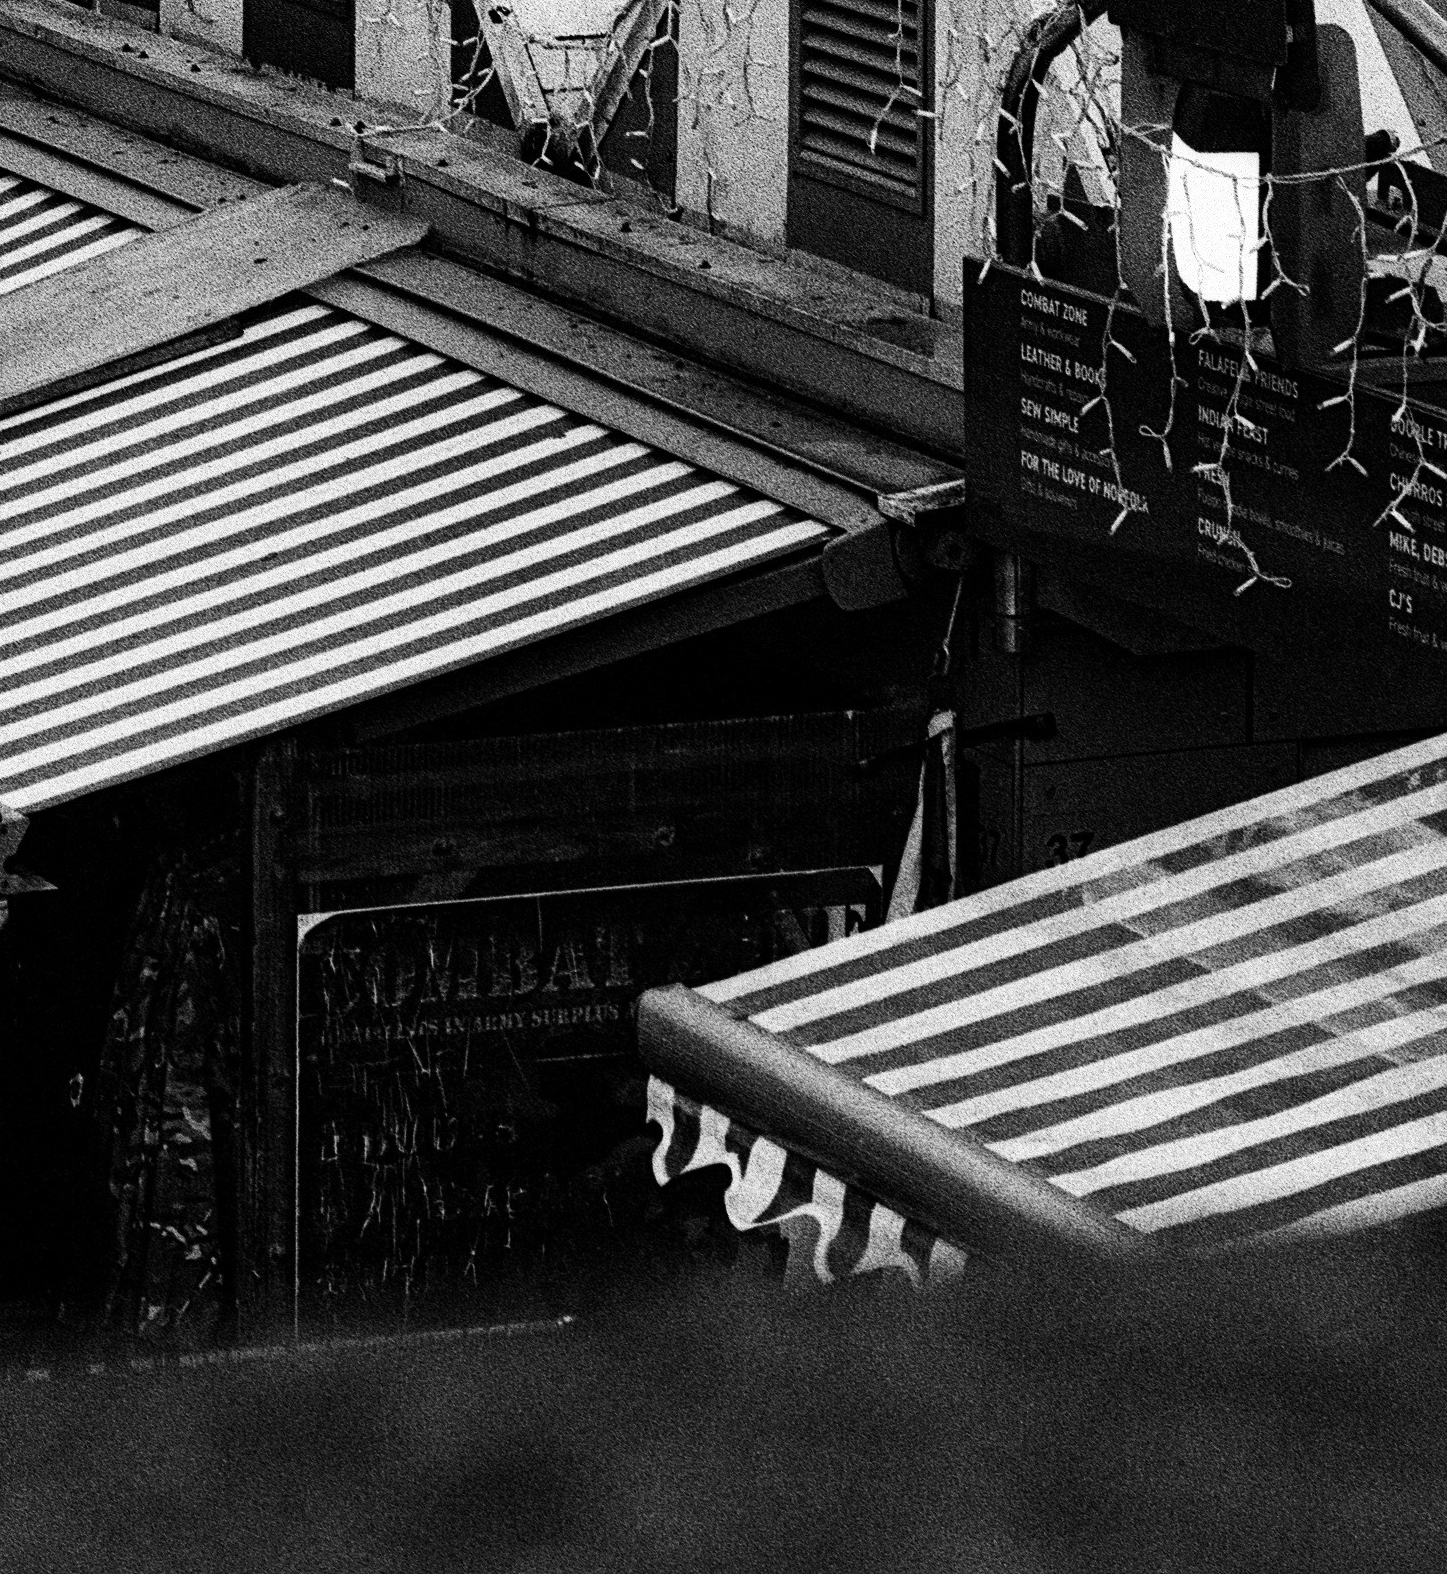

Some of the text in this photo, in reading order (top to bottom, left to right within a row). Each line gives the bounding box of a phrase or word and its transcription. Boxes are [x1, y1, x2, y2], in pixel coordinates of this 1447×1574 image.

[1020, 289, 1088, 328] COMBAT ZONE
[1020, 342, 1063, 374] LEATHER
[1064, 358, 1072, 377] &
[1254, 370, 1299, 400] FRIENDS
[1021, 396, 1080, 435] SEW SIMPLE
[1021, 449, 1039, 473] FOR
[1041, 457, 1060, 482] THE
[1062, 464, 1086, 491] LOVE
[1088, 475, 1102, 495] OF
[445, 1015, 469, 1037] IN
[473, 1010, 526, 1033] ARMY
[530, 1002, 620, 1029] SURPLUS
